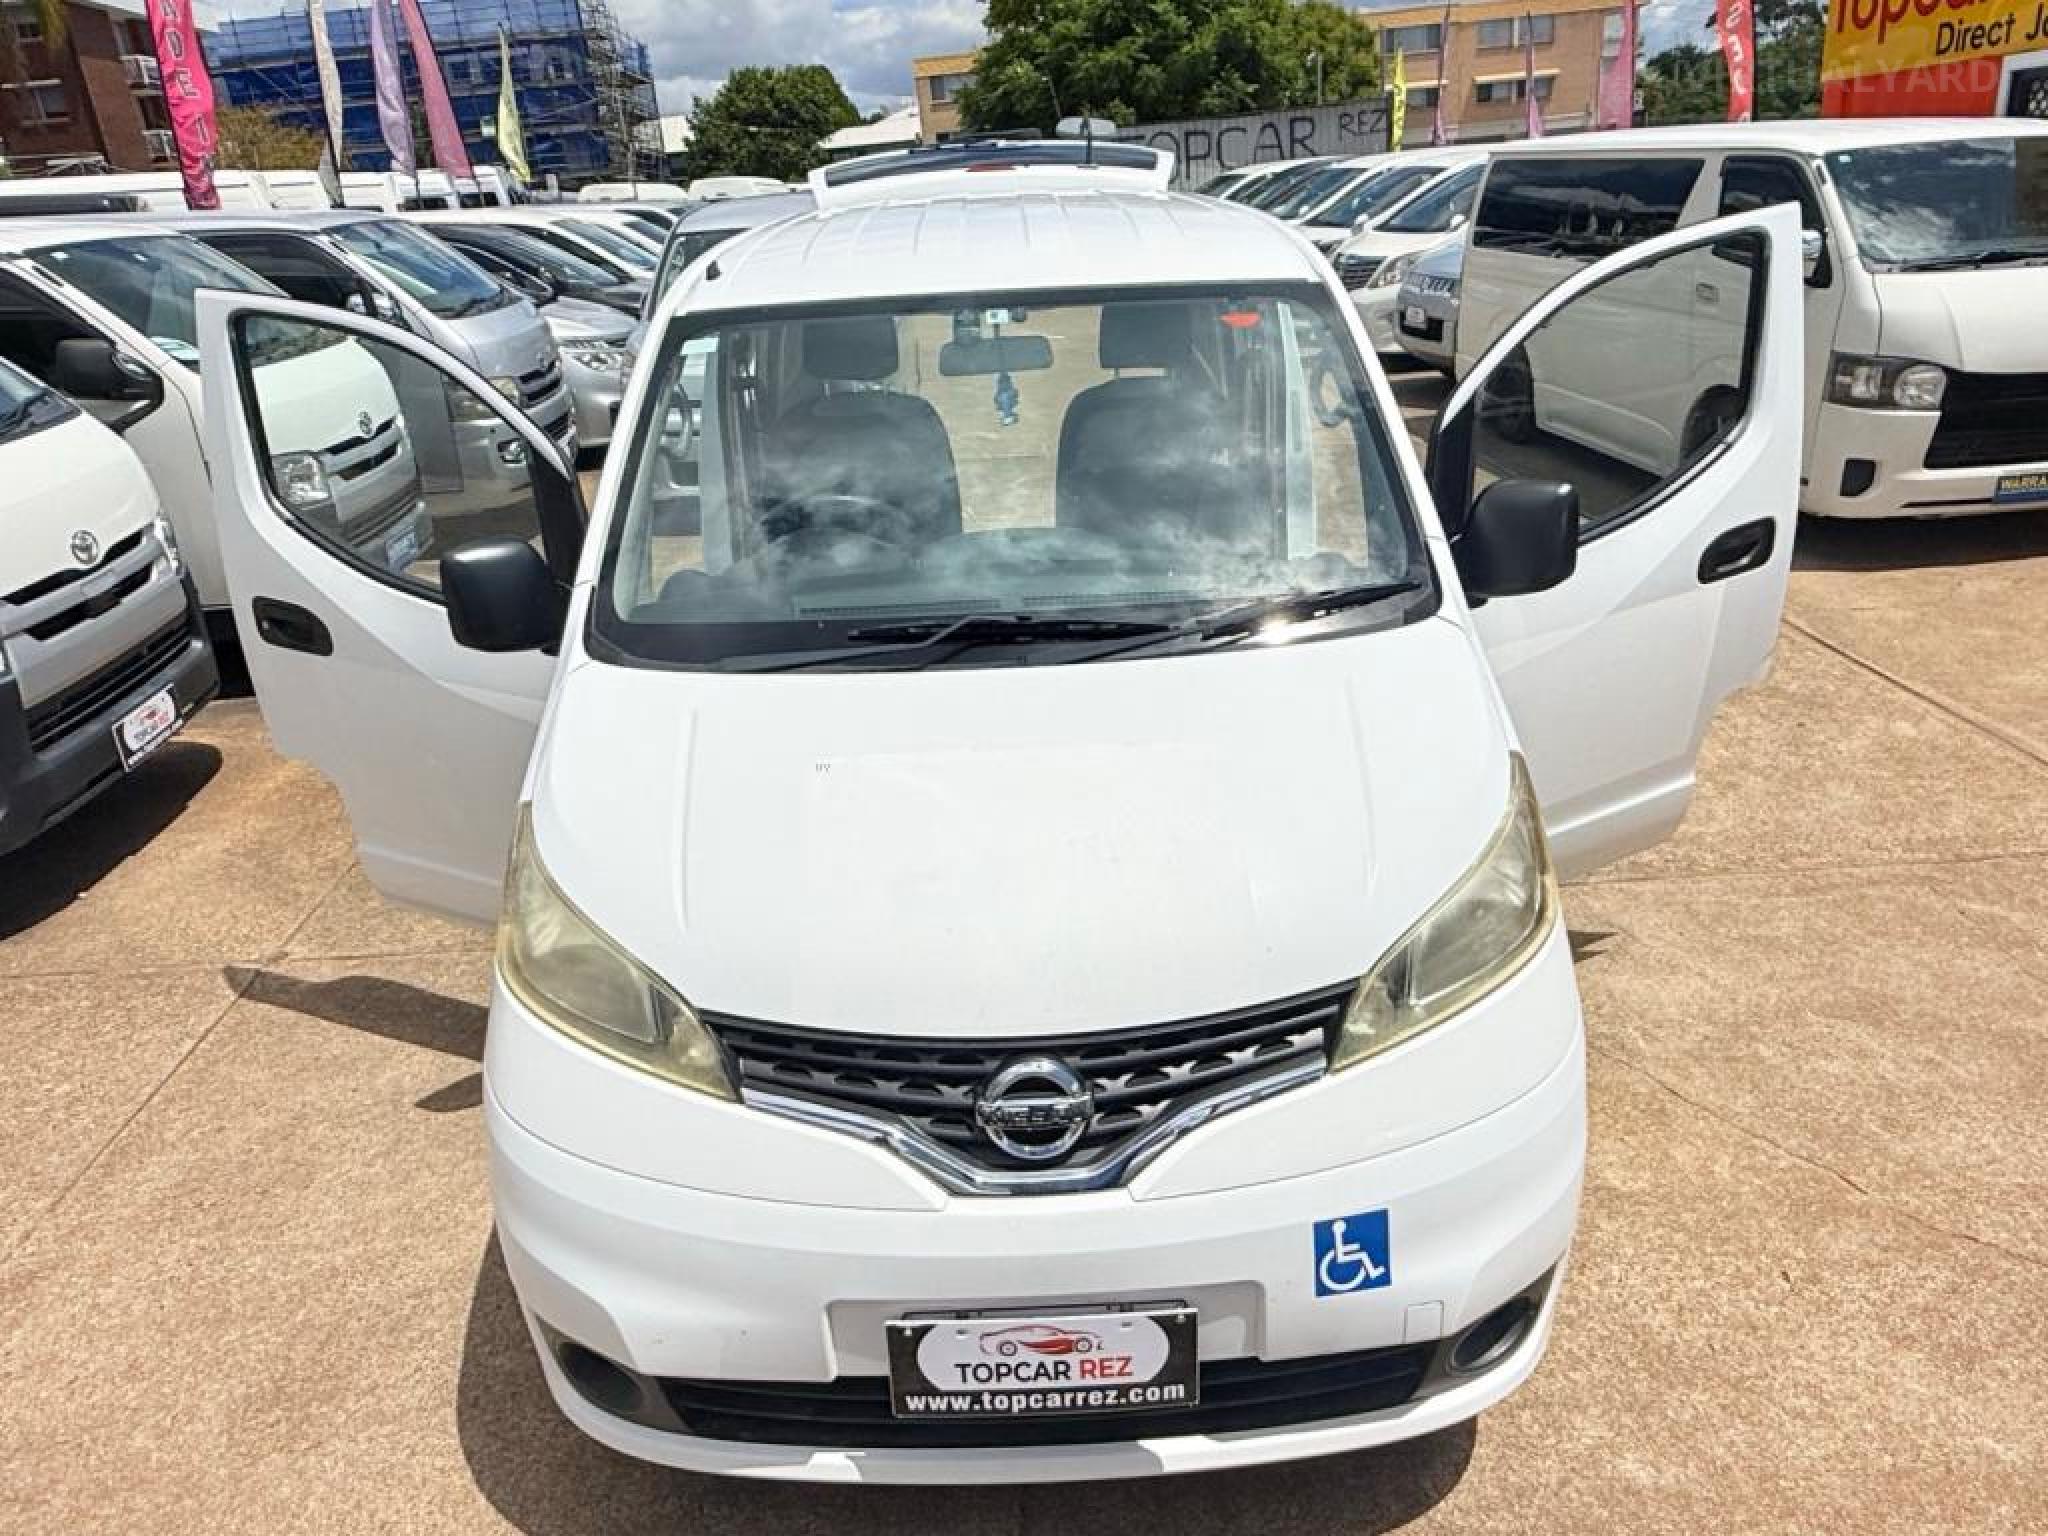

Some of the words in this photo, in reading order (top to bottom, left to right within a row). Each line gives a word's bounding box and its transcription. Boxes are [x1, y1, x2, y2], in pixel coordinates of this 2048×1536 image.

[1935, 12, 2017, 56] Direct
[1338, 109, 1387, 142] REZ
[954, 1360, 1072, 1384] TOPCAR
[1078, 1356, 1134, 1379] REZ
[905, 1383, 1185, 1413] www.topcarrez.com
